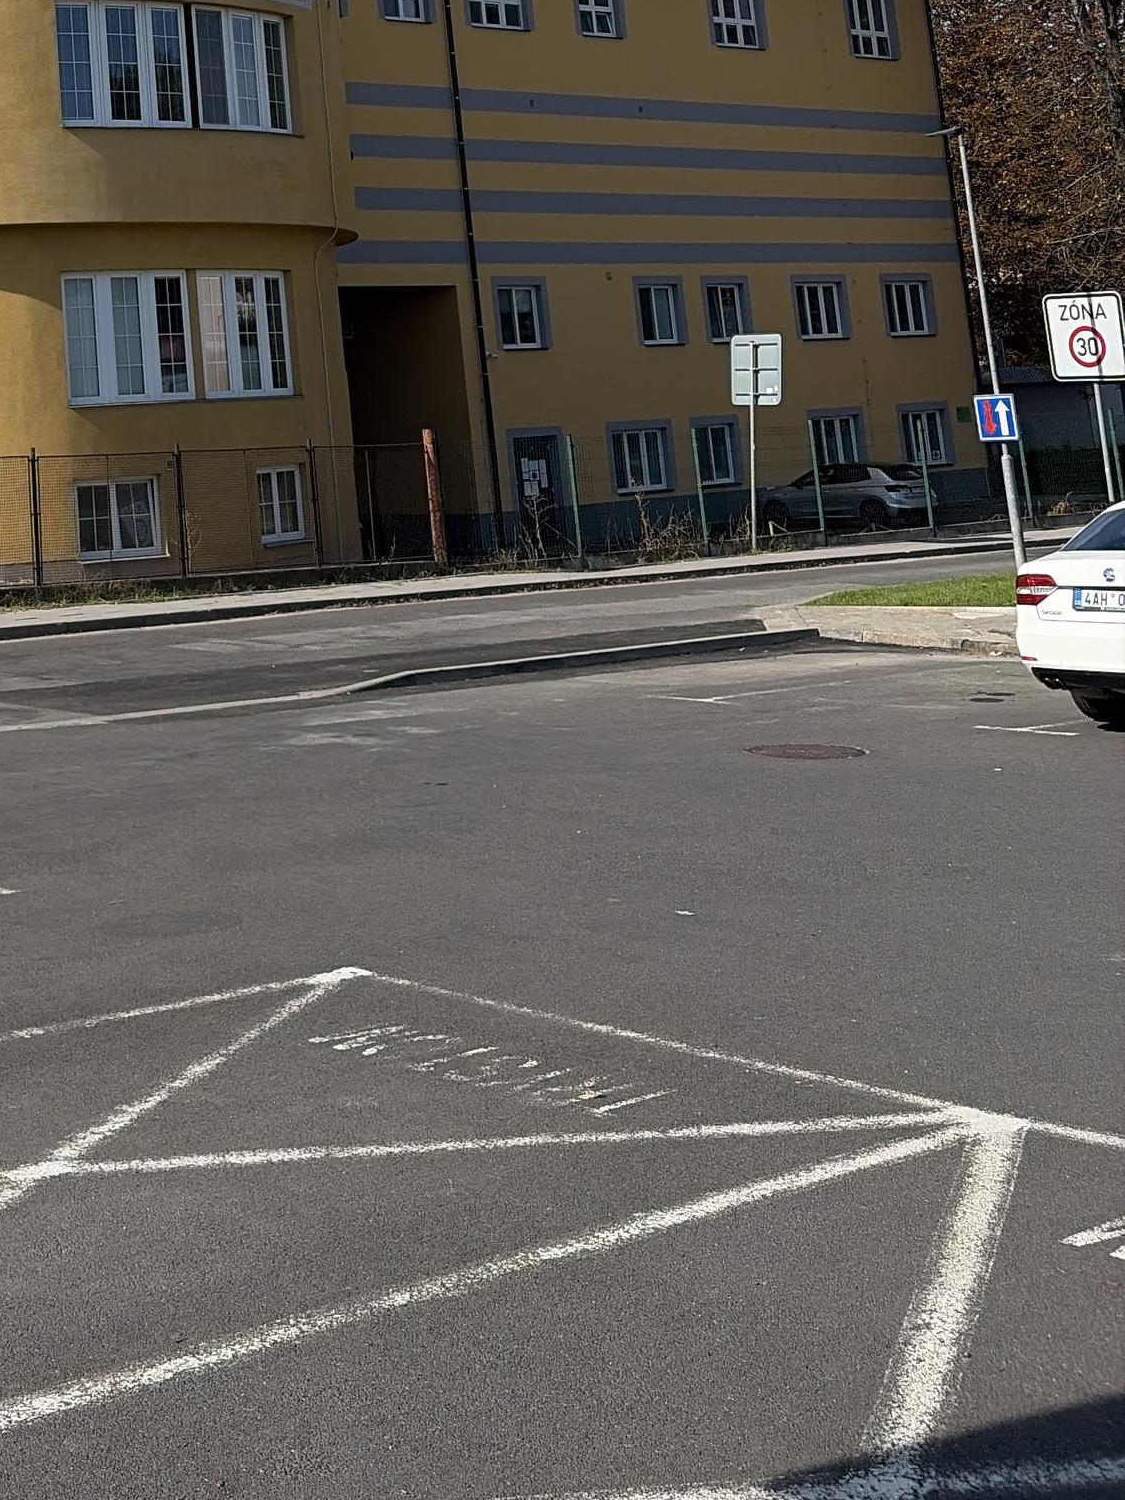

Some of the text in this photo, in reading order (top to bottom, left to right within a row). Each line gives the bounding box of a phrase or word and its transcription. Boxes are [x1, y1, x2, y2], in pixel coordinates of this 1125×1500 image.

[1058, 300, 1107, 320] ZÓNA
[1076, 337, 1099, 357] 30
[1084, 592, 1108, 606] 4AH
